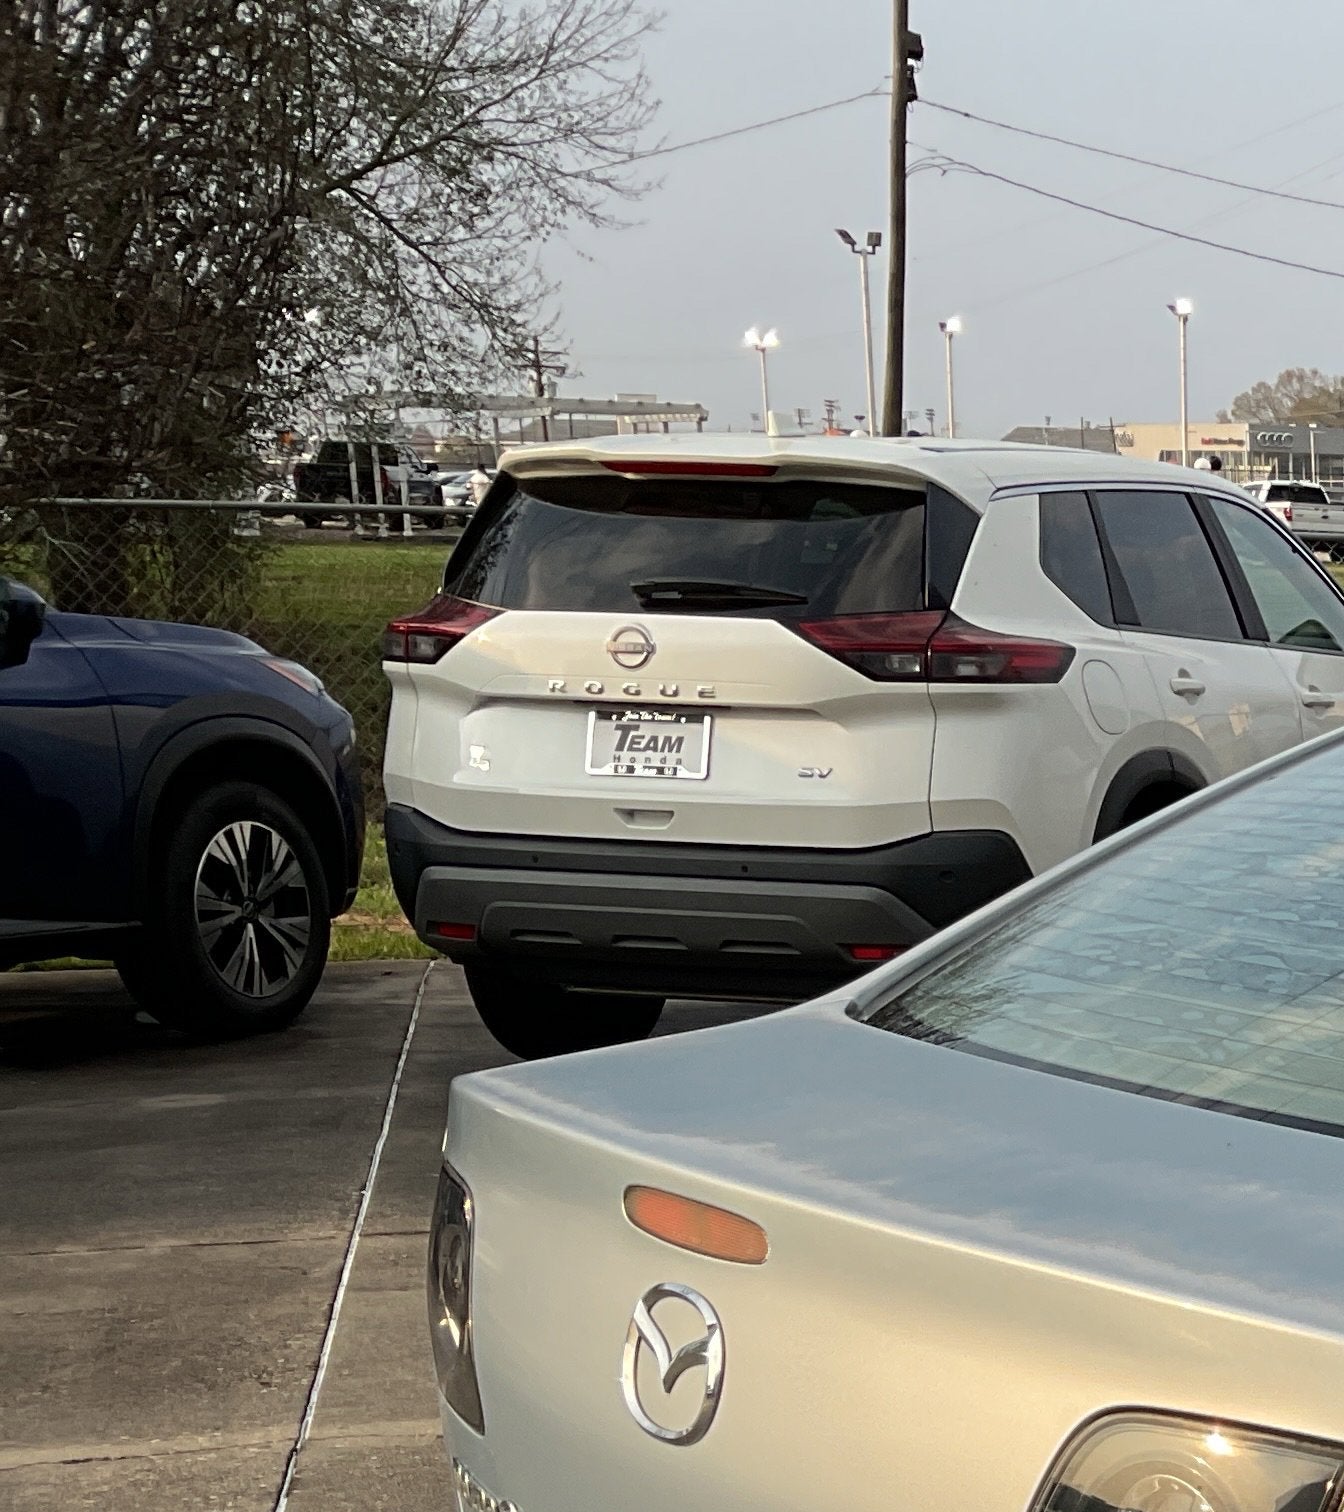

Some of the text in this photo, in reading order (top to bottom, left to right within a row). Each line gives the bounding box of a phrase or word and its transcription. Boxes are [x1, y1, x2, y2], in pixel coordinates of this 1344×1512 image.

[548, 679, 717, 699] ROGUE
[613, 723, 685, 754] TEAM
[613, 754, 682, 765] Honda
